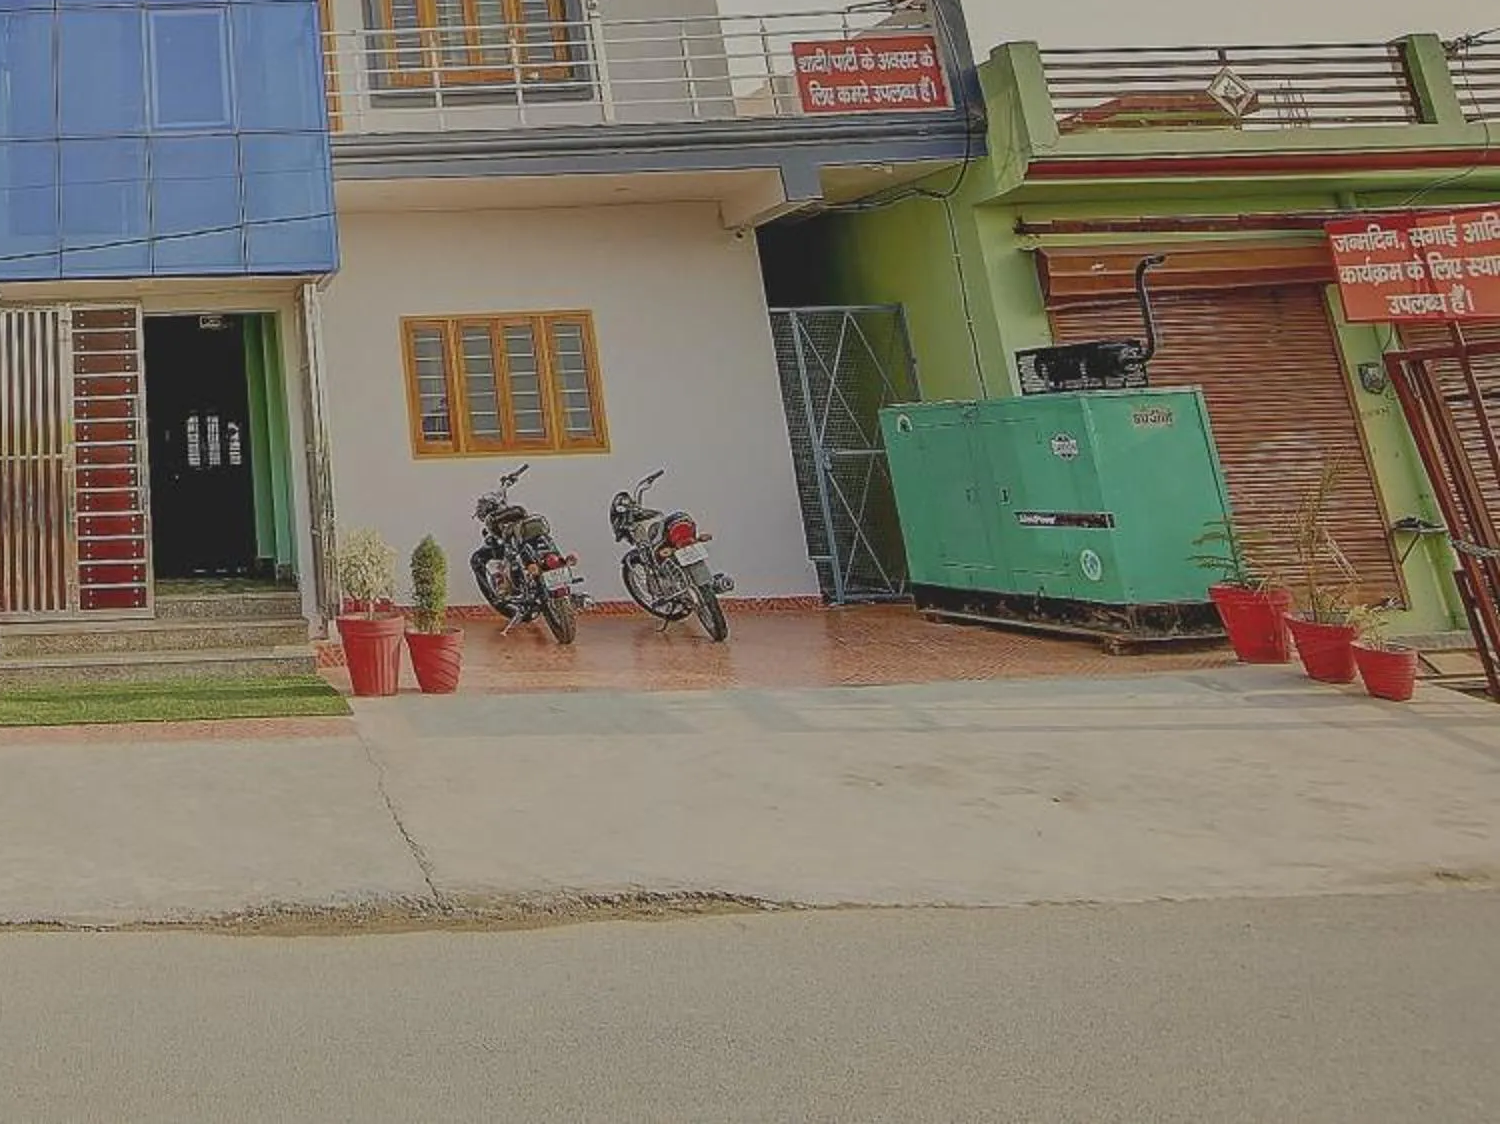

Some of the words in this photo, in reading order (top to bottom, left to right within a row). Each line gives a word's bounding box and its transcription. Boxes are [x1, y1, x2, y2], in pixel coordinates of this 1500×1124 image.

[860, 47, 875, 71] के
[1404, 253, 1426, 281] के
[1426, 252, 1463, 281] लिए
